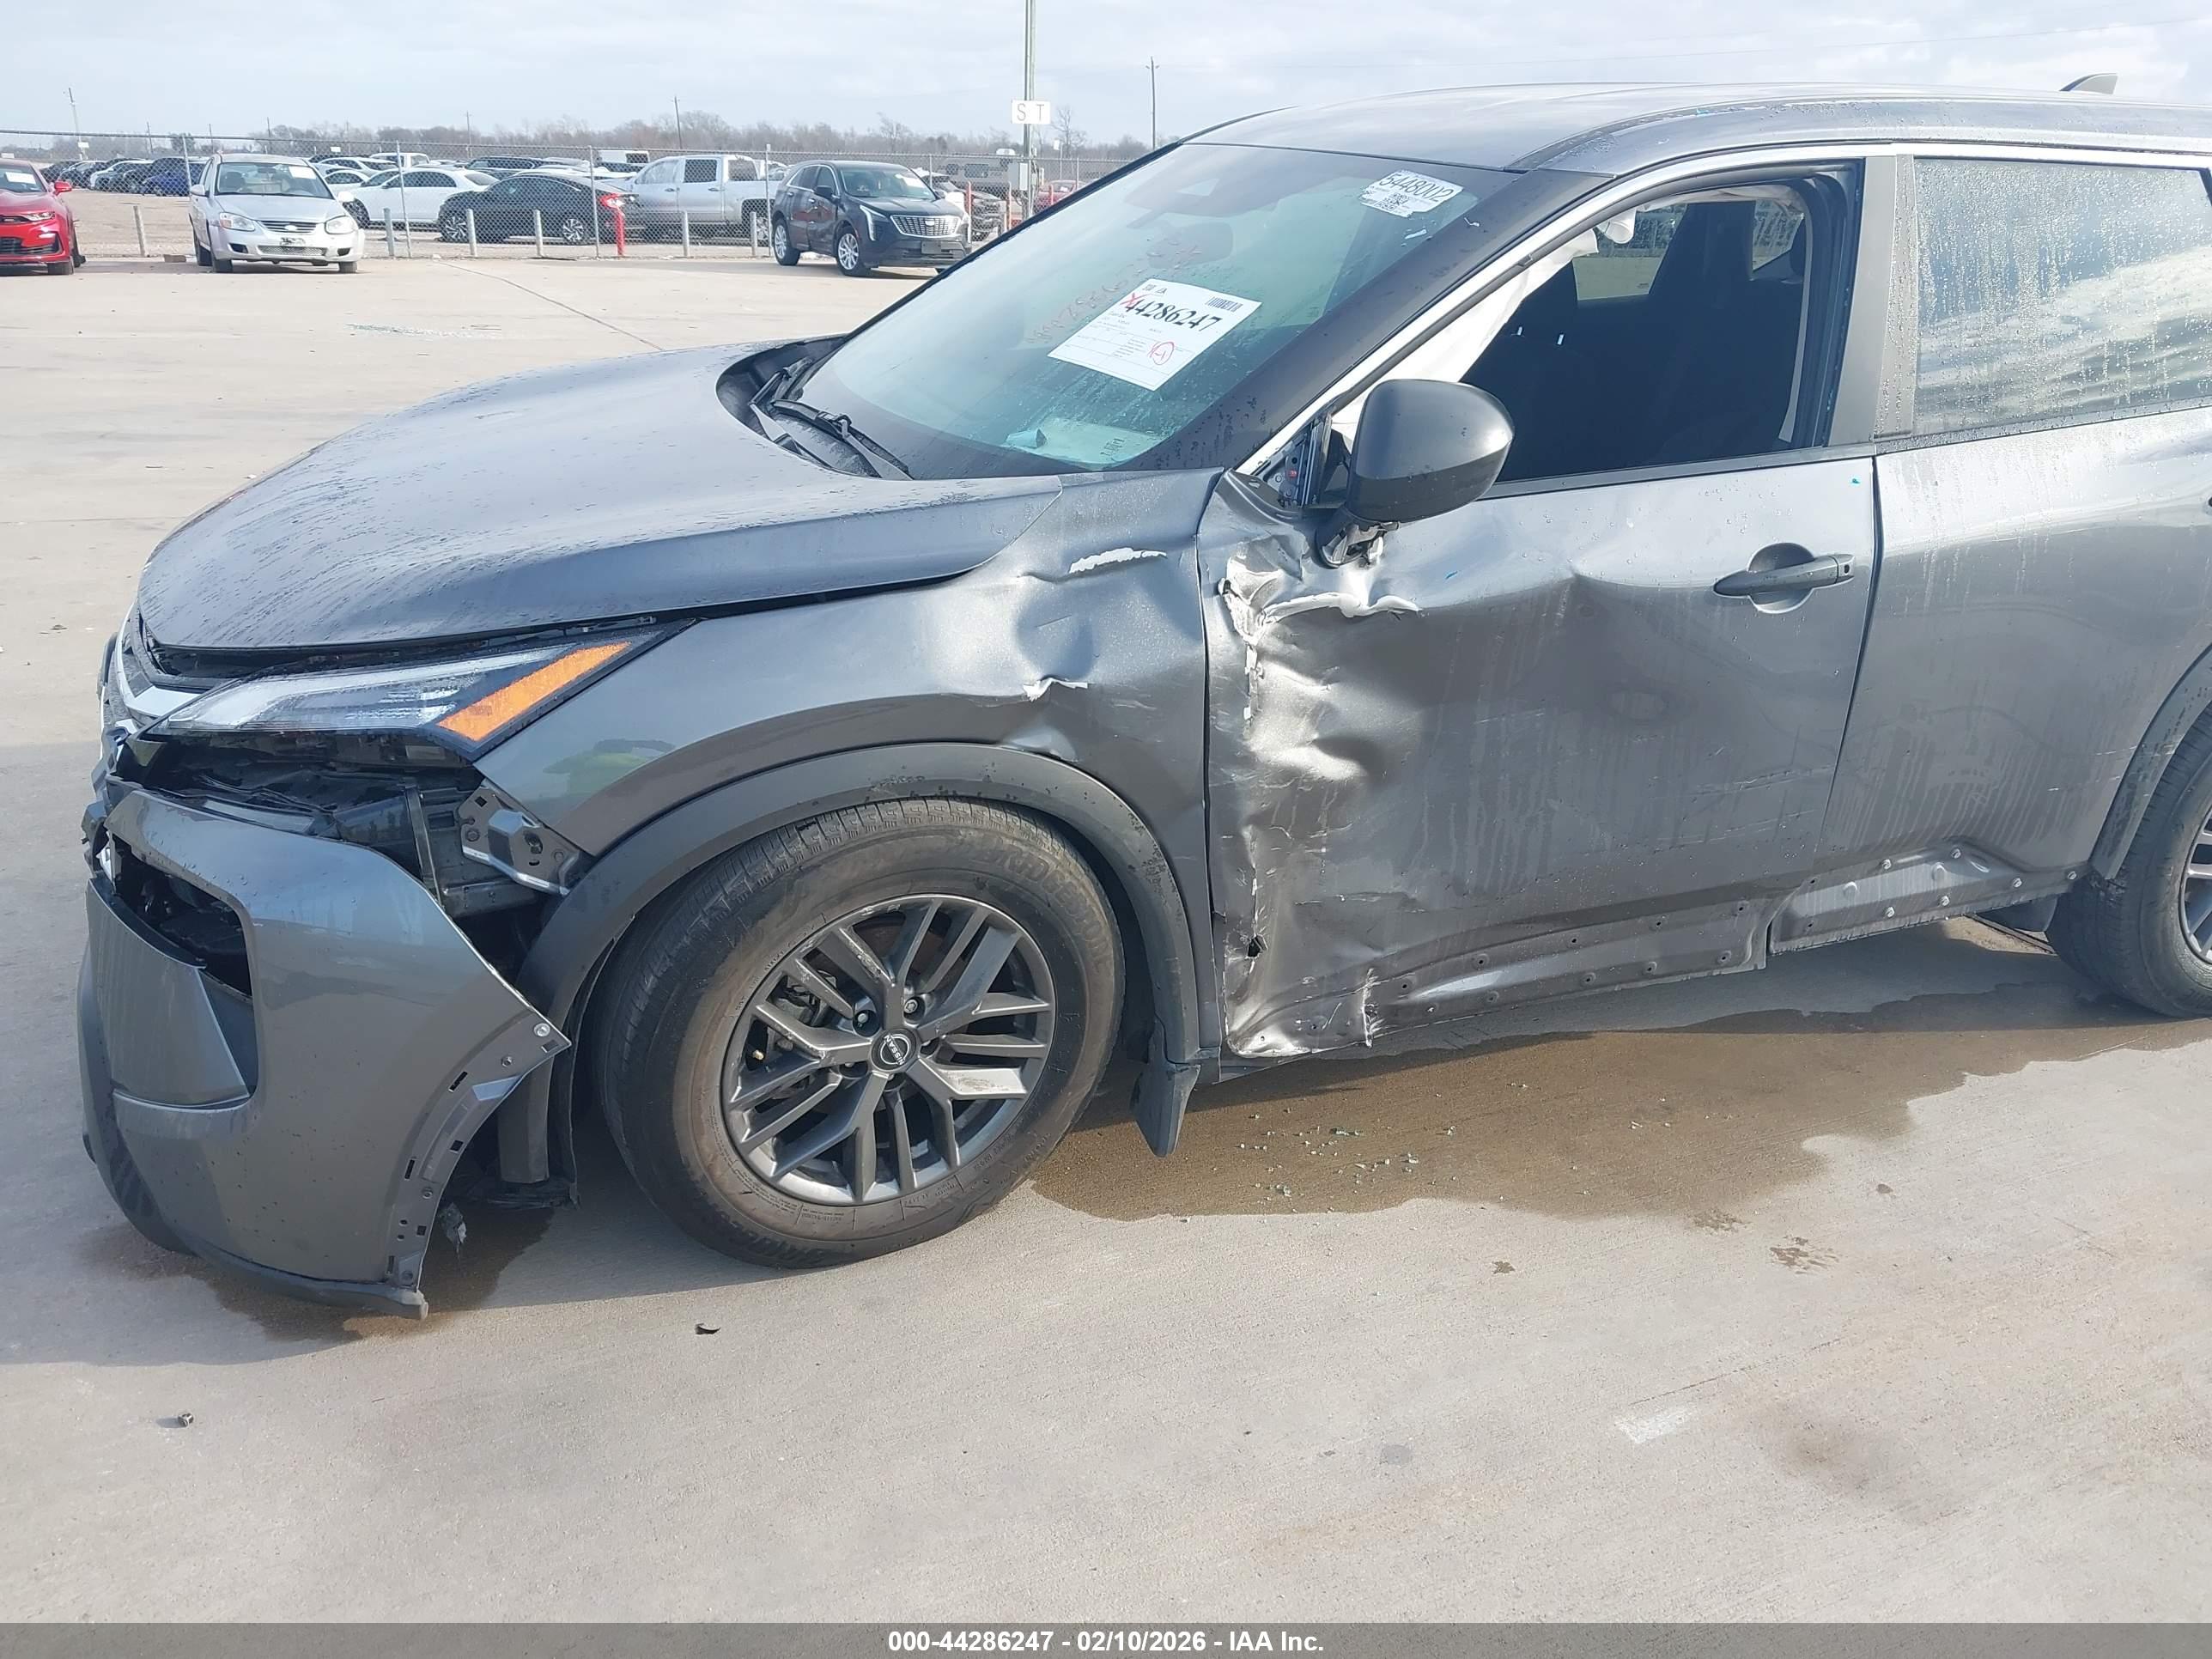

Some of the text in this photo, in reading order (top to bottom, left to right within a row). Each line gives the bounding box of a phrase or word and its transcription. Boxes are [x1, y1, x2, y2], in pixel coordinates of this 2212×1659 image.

[1017, 102, 1045, 122] S T
[1378, 173, 1455, 203] 5448002
[1123, 298, 1224, 332] 44286247
[883, 1032, 906, 1066] NISSAN
